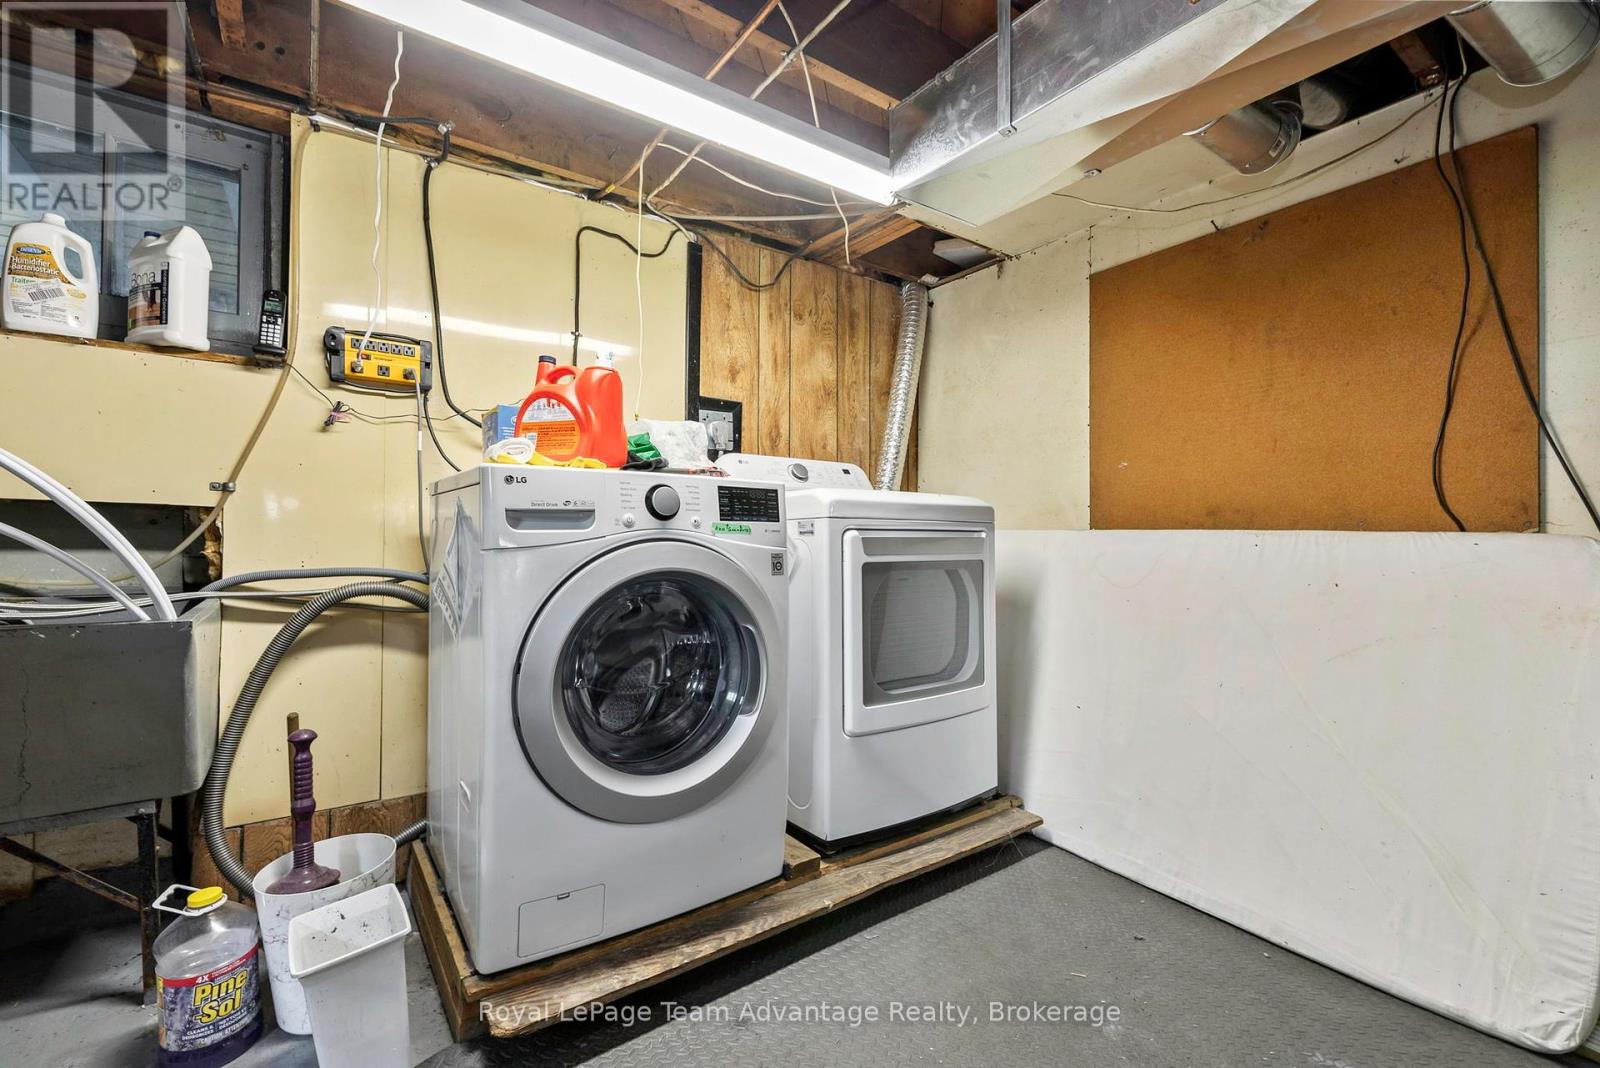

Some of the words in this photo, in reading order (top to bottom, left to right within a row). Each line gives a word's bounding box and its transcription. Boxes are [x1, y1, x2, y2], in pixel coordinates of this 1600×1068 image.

[12, 256, 51, 267] Humidifier
[11, 263, 60, 276] Bacteriostatic
[195, 975, 209, 984] 4X
[193, 968, 249, 1008] Pine
